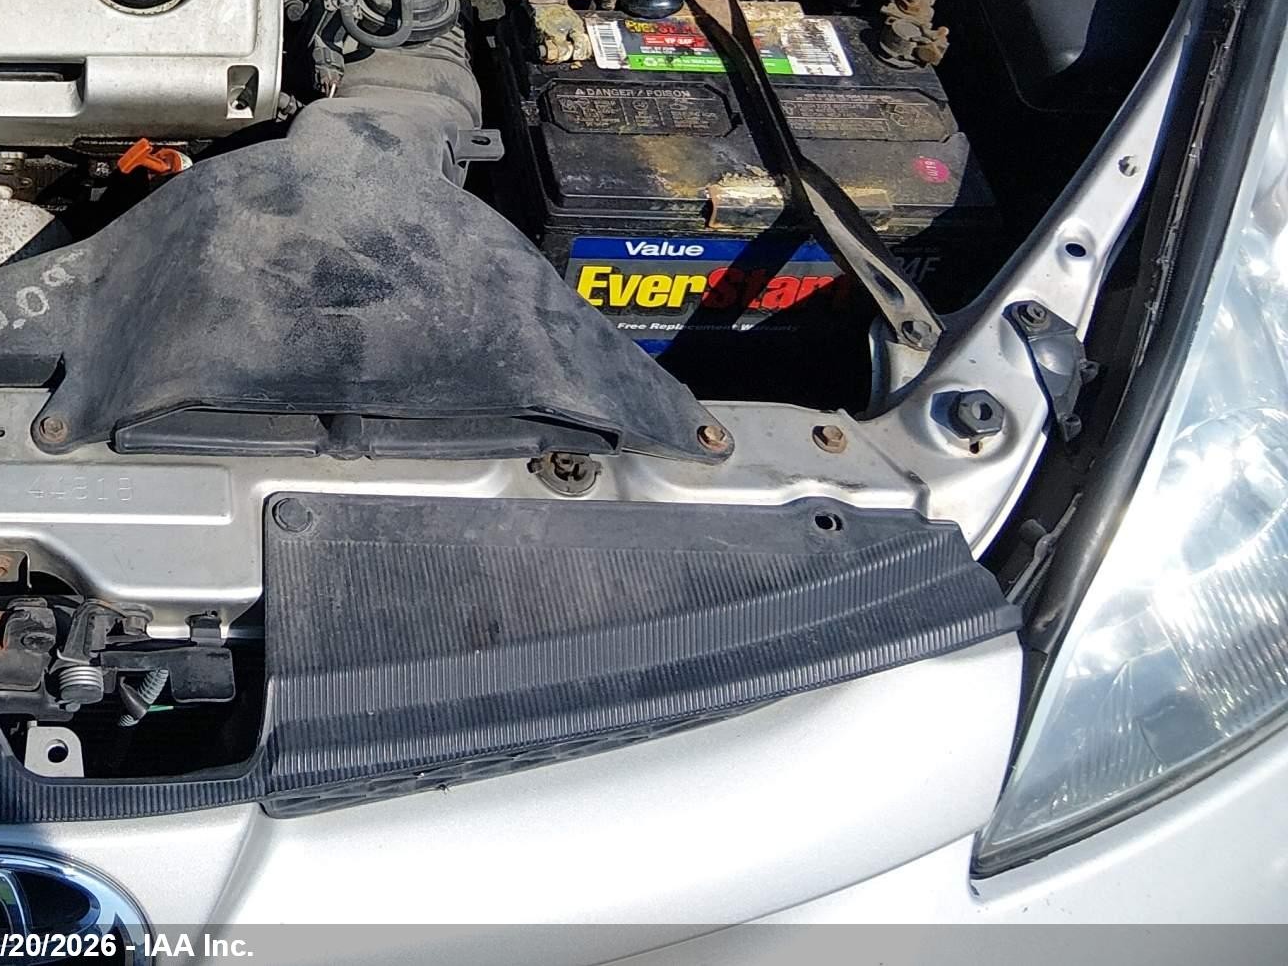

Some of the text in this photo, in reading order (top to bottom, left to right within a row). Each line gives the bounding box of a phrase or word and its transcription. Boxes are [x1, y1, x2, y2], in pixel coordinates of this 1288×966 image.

[587, 88, 635, 97] DANGER
[645, 89, 692, 98] POISON
[624, 240, 705, 257] Value
[616, 322, 647, 331] Free
